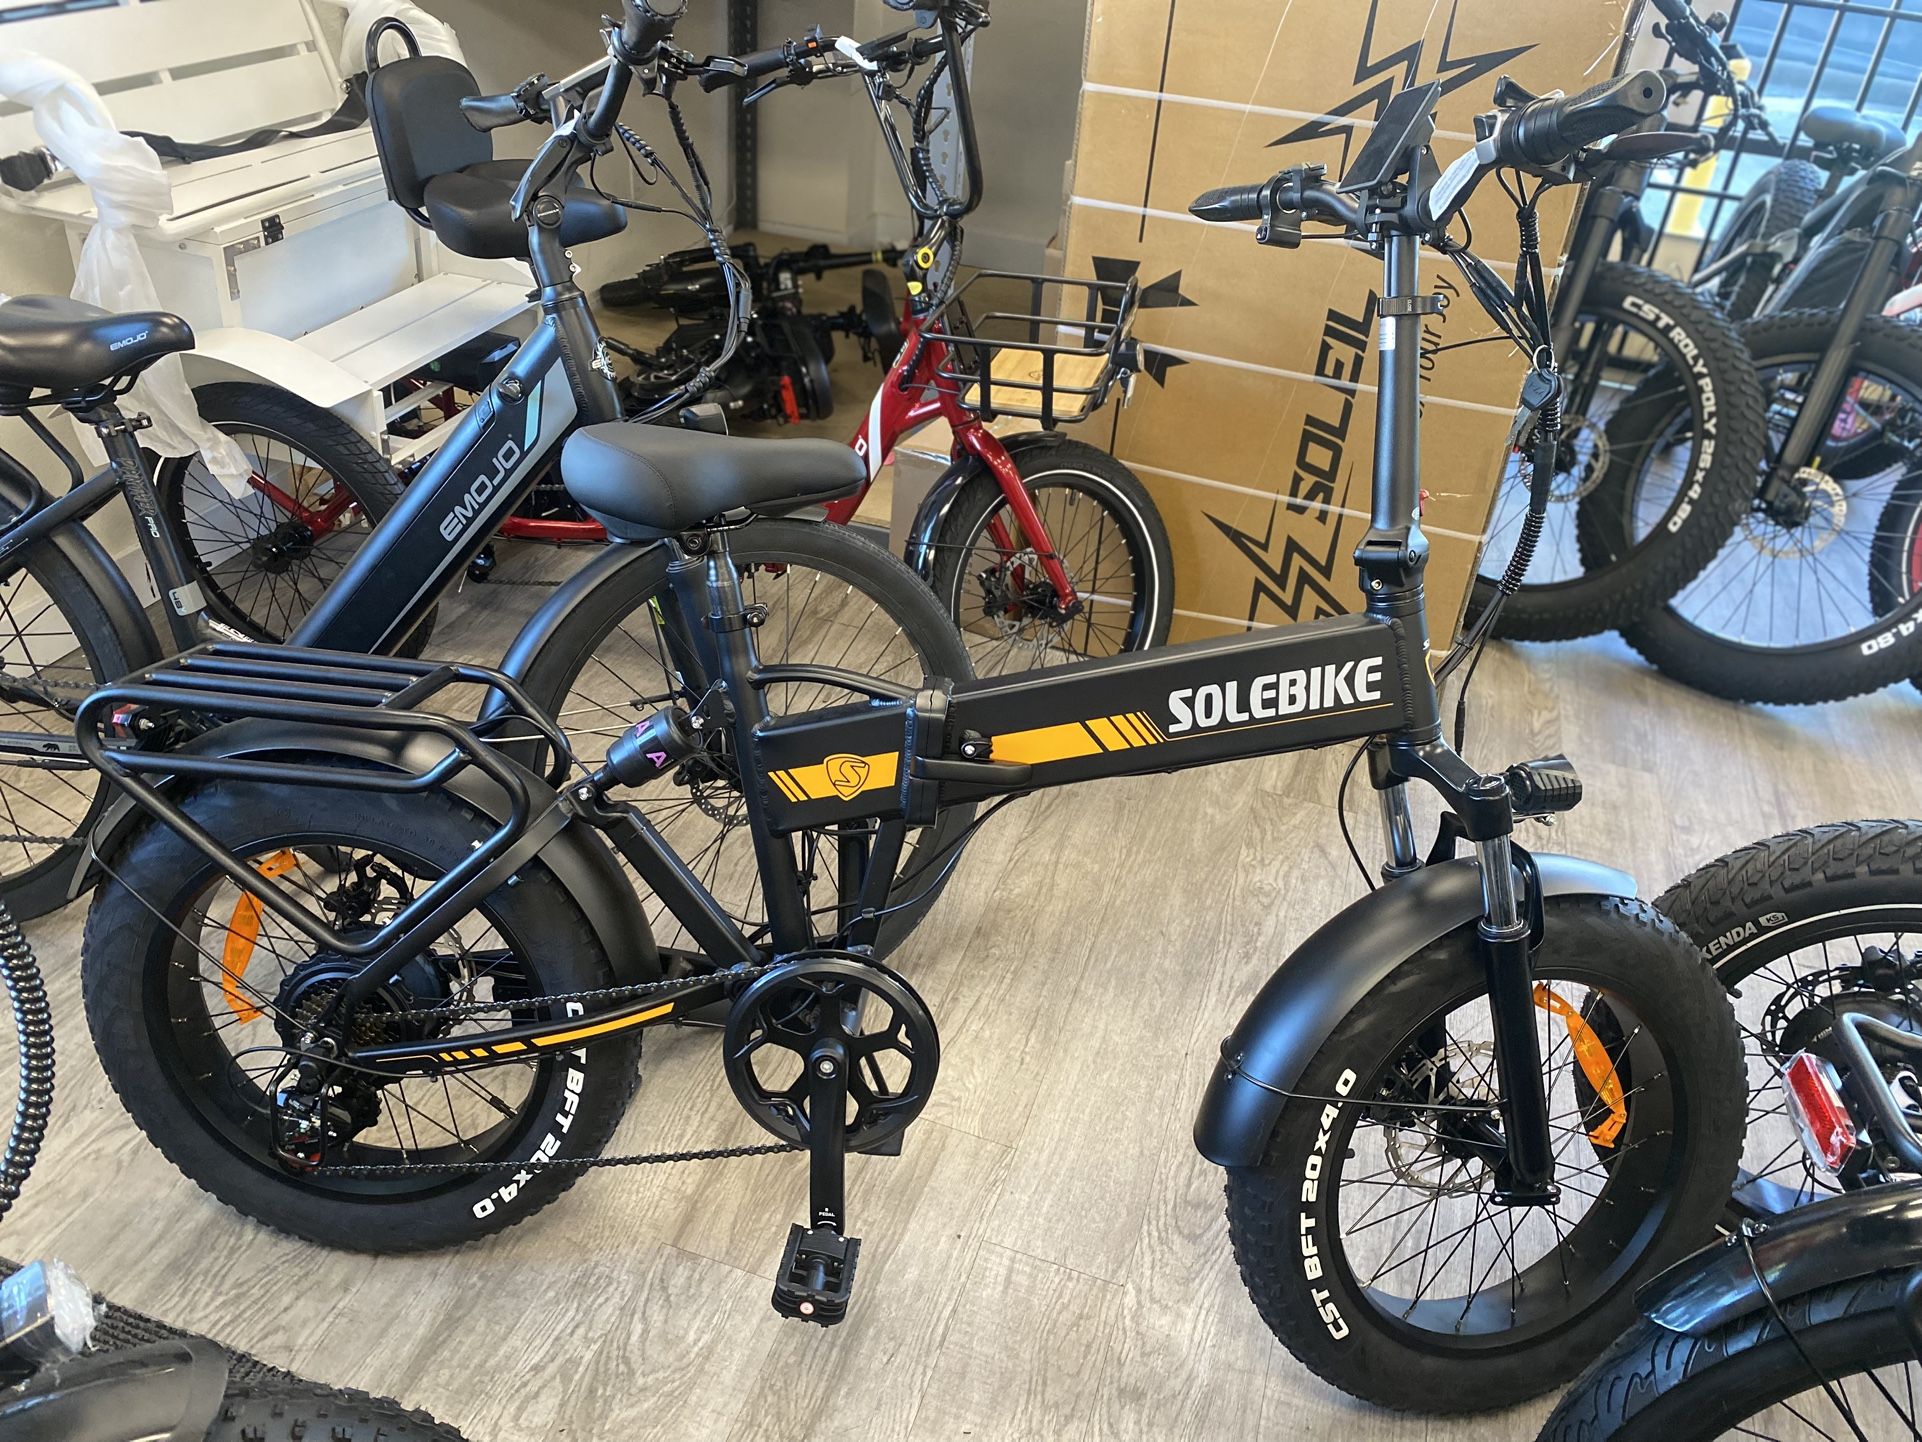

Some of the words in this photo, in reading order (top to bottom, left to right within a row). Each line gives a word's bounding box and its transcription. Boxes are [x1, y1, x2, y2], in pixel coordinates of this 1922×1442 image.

[110, 332, 148, 351] EMOJO
[1622, 295, 1675, 328] CST
[1669, 327, 1708, 375] ROLY
[1697, 377, 1717, 434] POLY
[1286, 288, 1378, 526] SOLEIL
[440, 440, 520, 541] EMOJO
[1168, 656, 1383, 733] SOLEBIKE
[555, 1068, 585, 1134] BFT
[1300, 1212, 1324, 1281] BFT
[1311, 1288, 1350, 1340] CST
